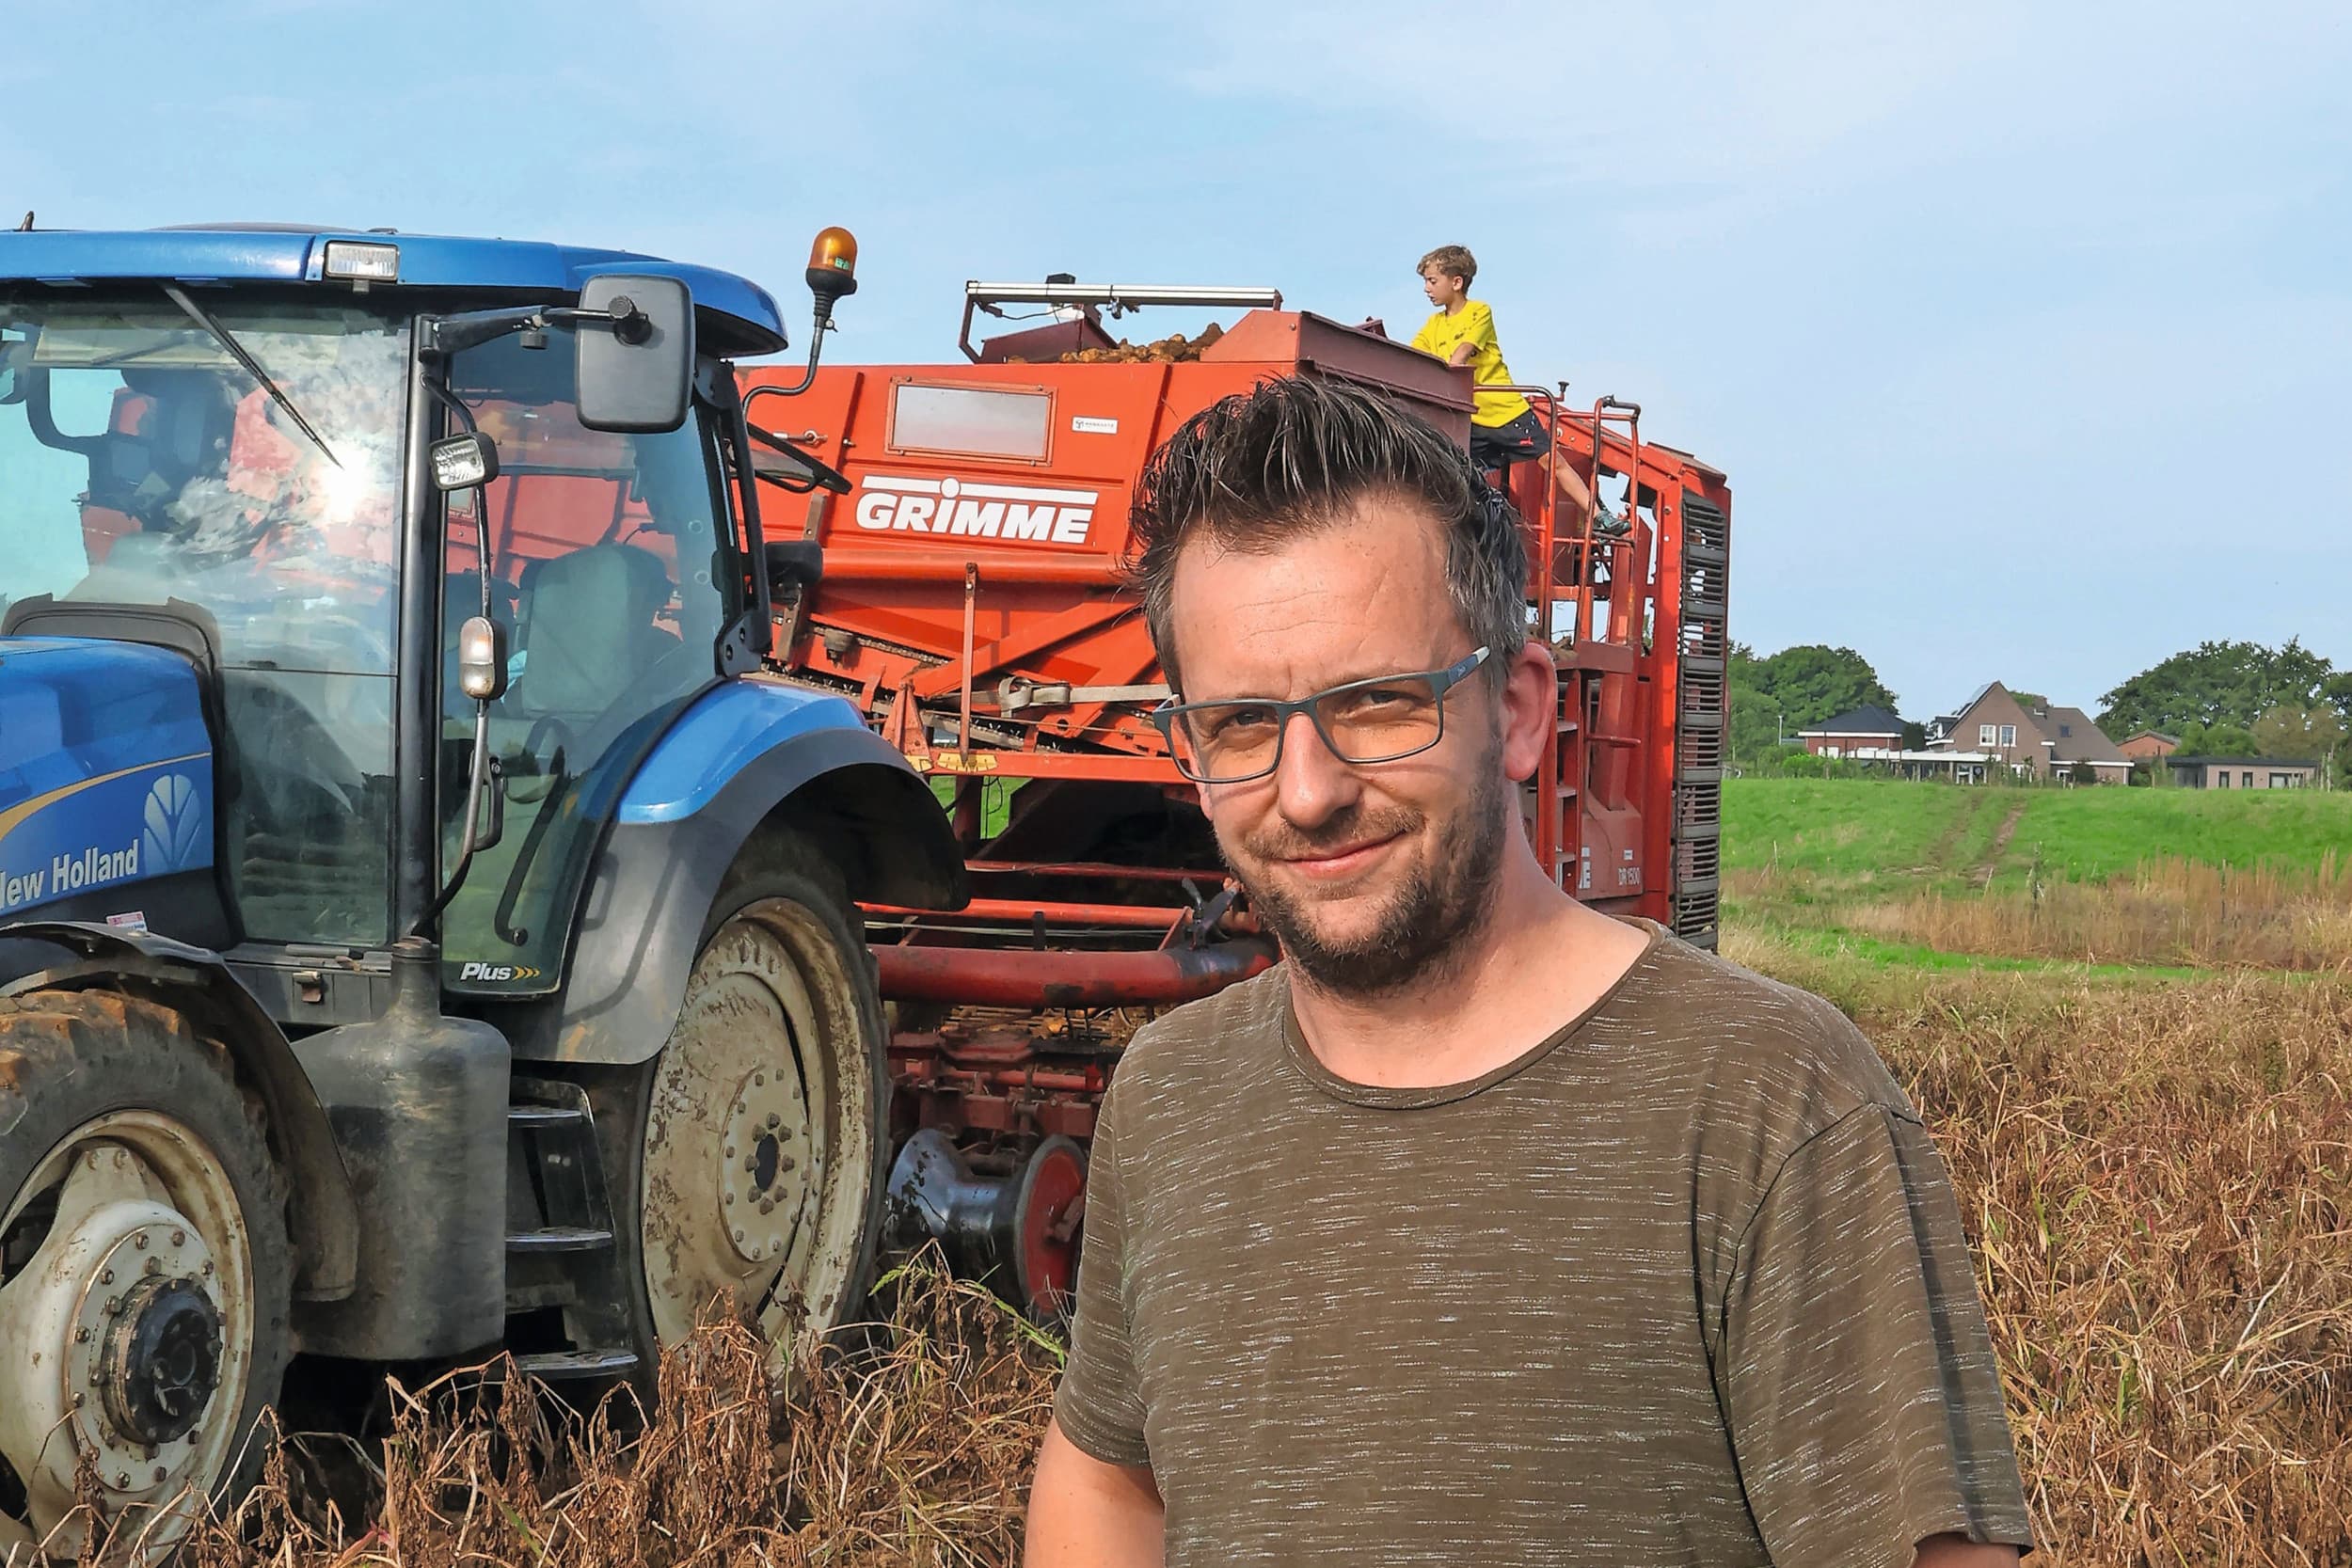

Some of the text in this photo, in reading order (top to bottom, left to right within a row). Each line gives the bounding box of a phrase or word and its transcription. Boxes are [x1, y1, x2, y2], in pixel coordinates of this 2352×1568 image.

[855, 476, 1093, 544] GRIMME
[52, 838, 139, 895] Holland
[459, 962, 513, 981] Plus
